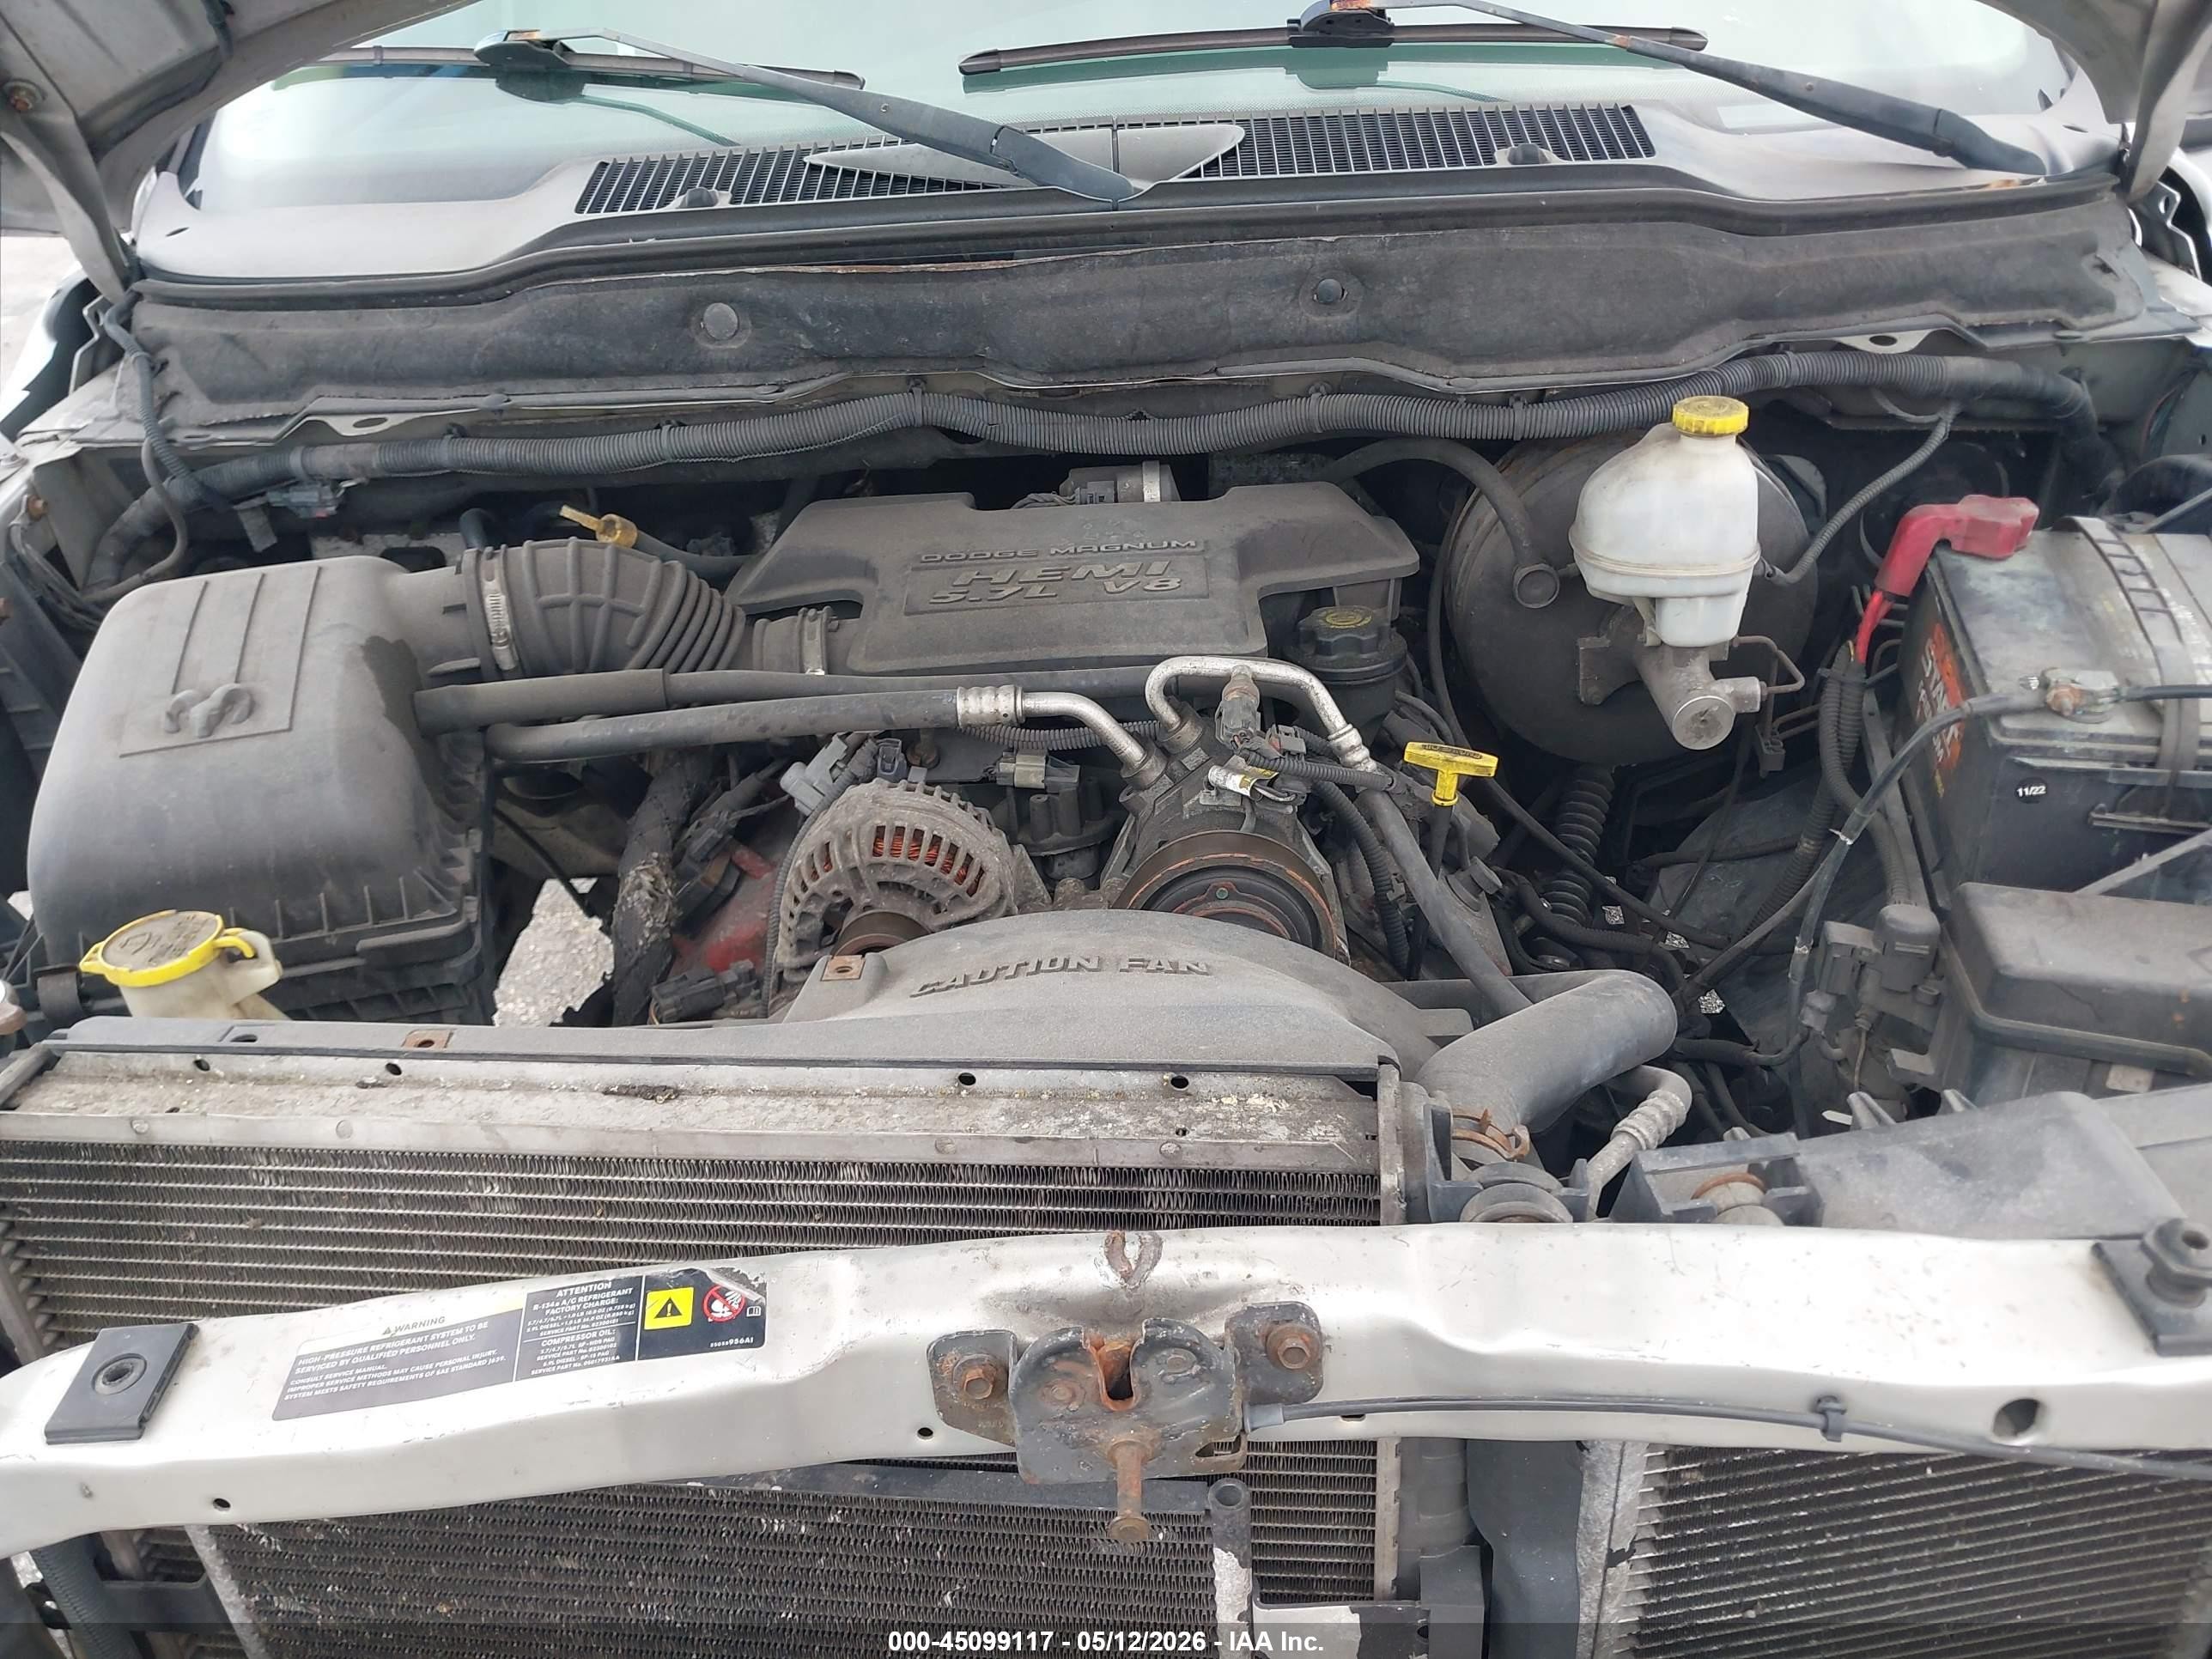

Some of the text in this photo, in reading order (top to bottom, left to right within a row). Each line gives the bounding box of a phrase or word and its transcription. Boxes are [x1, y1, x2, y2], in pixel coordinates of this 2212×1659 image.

[921, 540, 1196, 562] DODGE MAGNUM
[952, 560, 1171, 586] HEMI
[929, 577, 1182, 604] 5.7L V8
[2016, 785, 2046, 797] 11/22
[909, 955, 1213, 998] CAUTION FAN
[556, 1281, 611, 1297] ATTENTION
[561, 1297, 577, 1306] A/C
[578, 1287, 634, 1303] REFRIGERANT
[545, 1297, 618, 1316] FACTORY CHARGE:
[394, 1316, 446, 1333] WARNING
[369, 1335, 429, 1352] REFRIGERANT
[430, 1327, 465, 1340] SYSTEM
[465, 1323, 476, 1334] TO
[477, 1322, 489, 1330] BE
[541, 1331, 597, 1347] COMPRESSOR
[295, 1334, 476, 1374] SERVICED BY QUALIFIED PERSONNEL ONLY.
[284, 1391, 313, 1401] SYSTEM
[314, 1386, 338, 1396] MEETS
[339, 1382, 367, 1391] SAFETY
[367, 1372, 424, 1387] REQUIREMENTS
[451, 1359, 487, 1373] STANDARD
[288, 1382, 324, 1393] IMPROPER
[325, 1376, 355, 1387] SERVICE
[356, 1370, 392, 1381] METHODS
[392, 1367, 410, 1376] MAY
[410, 1363, 434, 1373] CAUSE
[434, 1357, 471, 1368] PERSONAL
[290, 1375, 323, 1385] CONSULT
[324, 1369, 354, 1380] SERVICE
